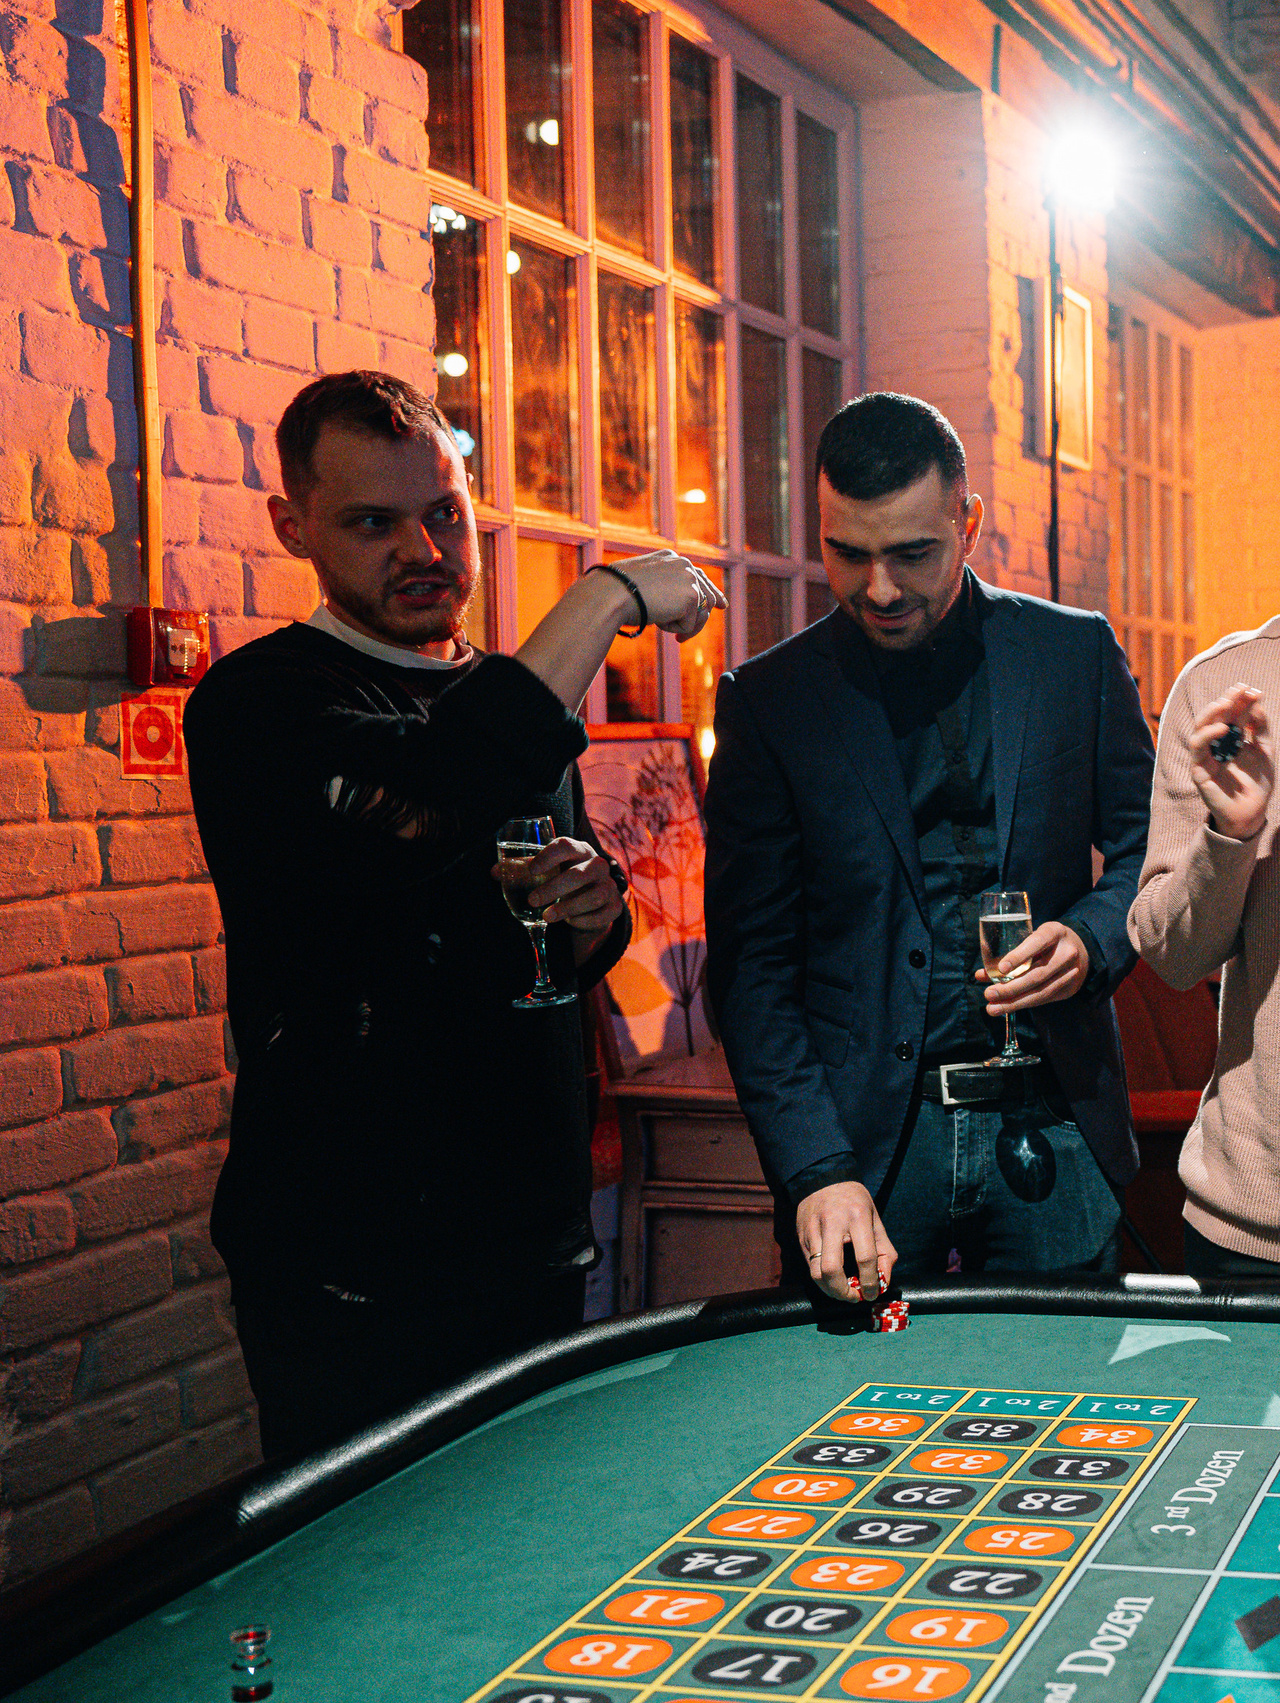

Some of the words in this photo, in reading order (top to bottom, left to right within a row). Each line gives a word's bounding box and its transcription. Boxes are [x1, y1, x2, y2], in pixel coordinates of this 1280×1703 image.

[870, 1391, 887, 1402] 1
[895, 1393, 922, 1402] to
[928, 1394, 951, 1405] 2
[978, 1396, 996, 1408] 1
[1005, 1398, 1031, 1406] to
[1037, 1399, 1060, 1411] 2
[1089, 1402, 1106, 1413] 1
[1114, 1403, 1141, 1412] to
[1149, 1404, 1172, 1416] 2
[849, 1415, 910, 1432] 36
[961, 1422, 1019, 1438] 35
[1080, 1427, 1136, 1445] 34
[812, 1446, 876, 1463] 33
[930, 1452, 992, 1469] 32
[1054, 1458, 1111, 1478] 31
[1170, 1449, 1245, 1505] Dozen
[773, 1479, 838, 1497] 30
[892, 1486, 962, 1506] 29
[1017, 1492, 1087, 1512] 28
[723, 1515, 803, 1536] 27
[853, 1522, 928, 1543] 26
[986, 1530, 1055, 1550] 25
[681, 1552, 758, 1576] 24
[810, 1562, 887, 1585] 23
[949, 1570, 1027, 1595] 22
[630, 1595, 707, 1620] 21
[764, 1605, 847, 1632] 20
[910, 1617, 985, 1642] 19
[1056, 1596, 1155, 1676] Dozen
[569, 1641, 651, 1669] 18
[709, 1653, 801, 1683] 17
[867, 1664, 948, 1694] 16
